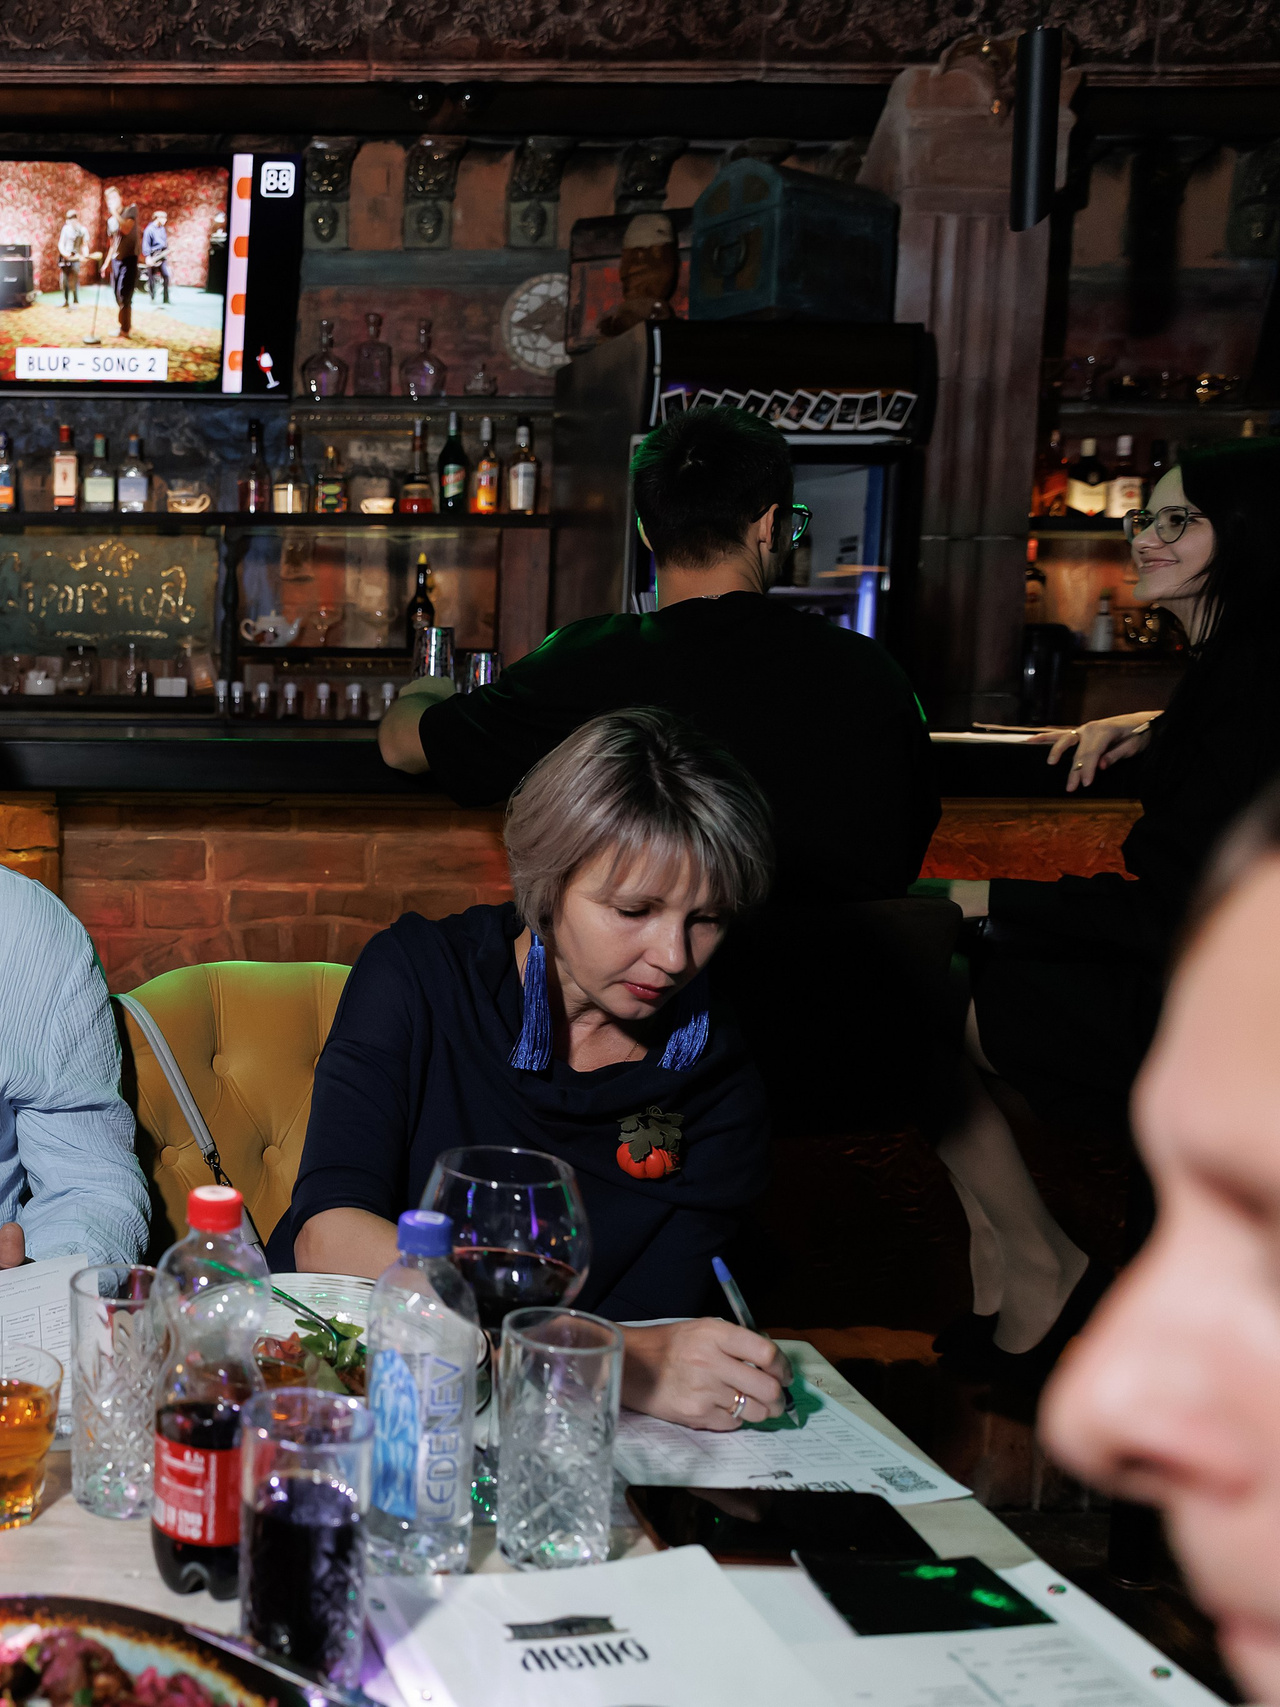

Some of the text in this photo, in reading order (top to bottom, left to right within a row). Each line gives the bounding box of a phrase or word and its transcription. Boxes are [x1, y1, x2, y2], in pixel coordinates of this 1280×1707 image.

[28, 356, 70, 371] BLUR
[92, 356, 139, 373] SONG
[148, 357, 157, 372] 2
[425, 1357, 463, 1522] LEDENEV
